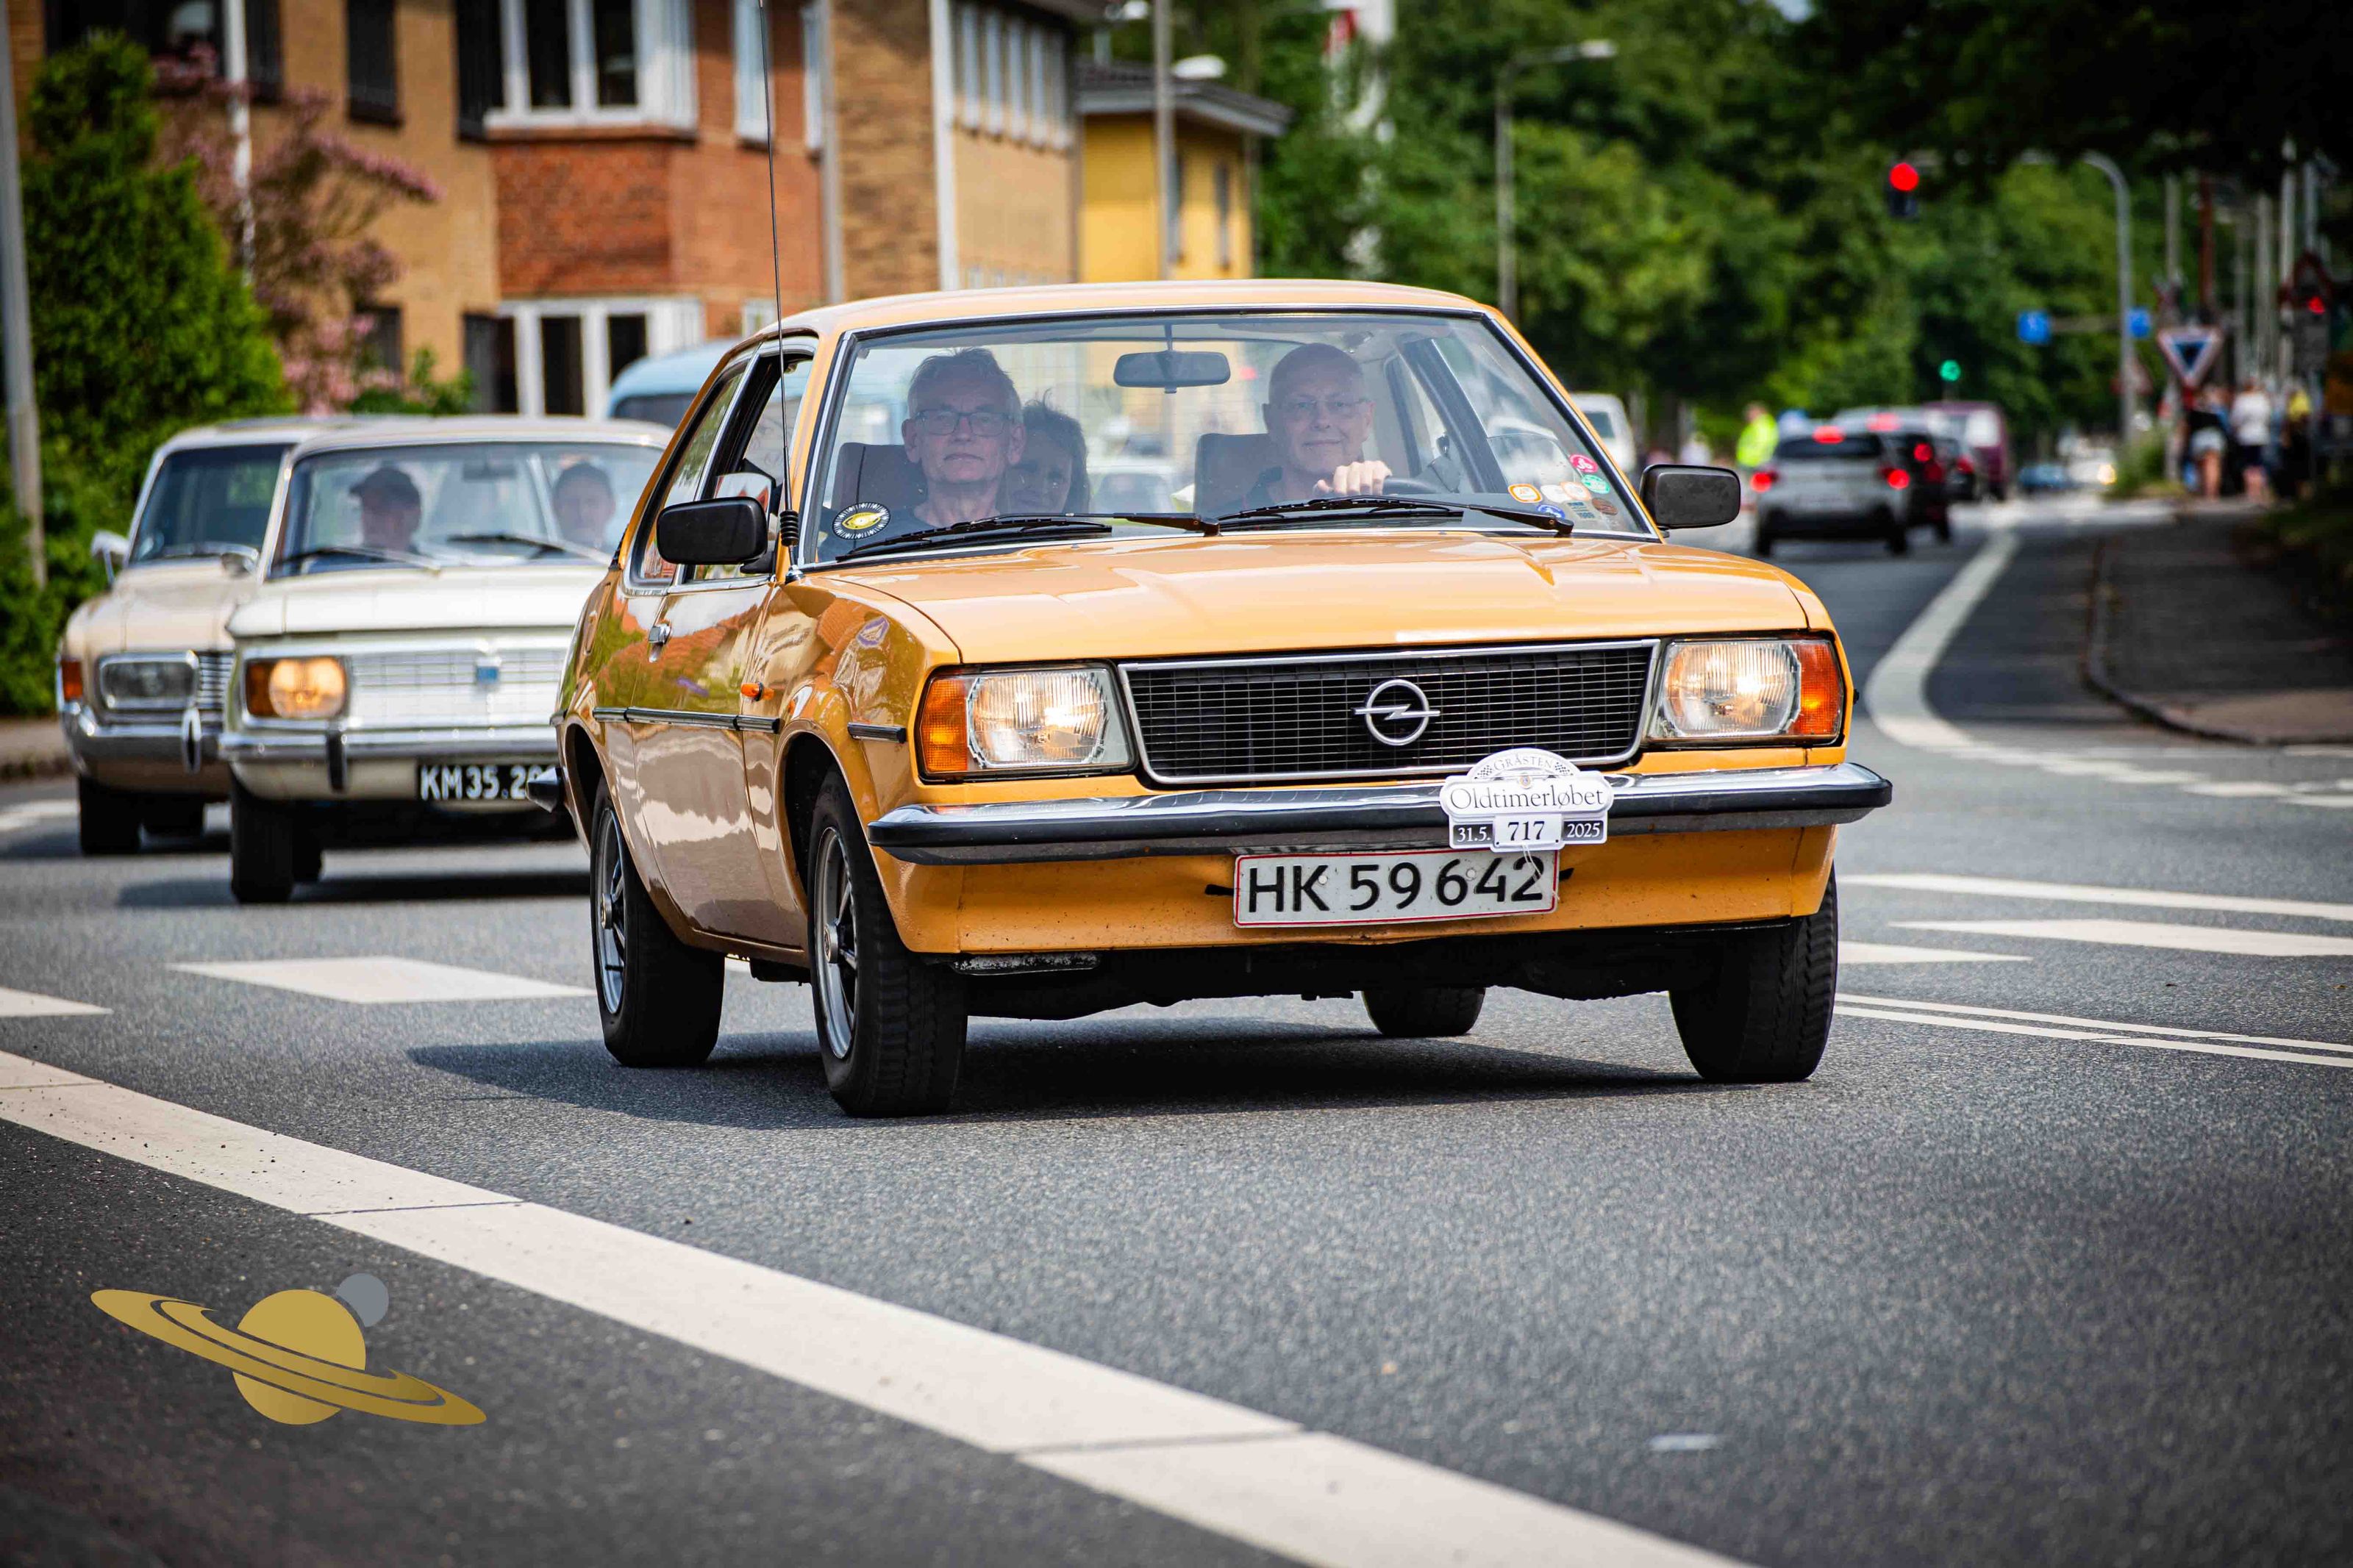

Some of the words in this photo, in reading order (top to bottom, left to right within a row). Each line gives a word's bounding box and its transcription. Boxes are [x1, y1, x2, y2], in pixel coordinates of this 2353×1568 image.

[1493, 754, 1554, 771] GRÅSTEN
[1450, 784, 1604, 809] Oldtimerløbet
[1457, 826, 1491, 842] 31.5.
[1507, 820, 1545, 842] 717
[1567, 823, 1601, 839] 2025
[1248, 864, 1329, 913] HK
